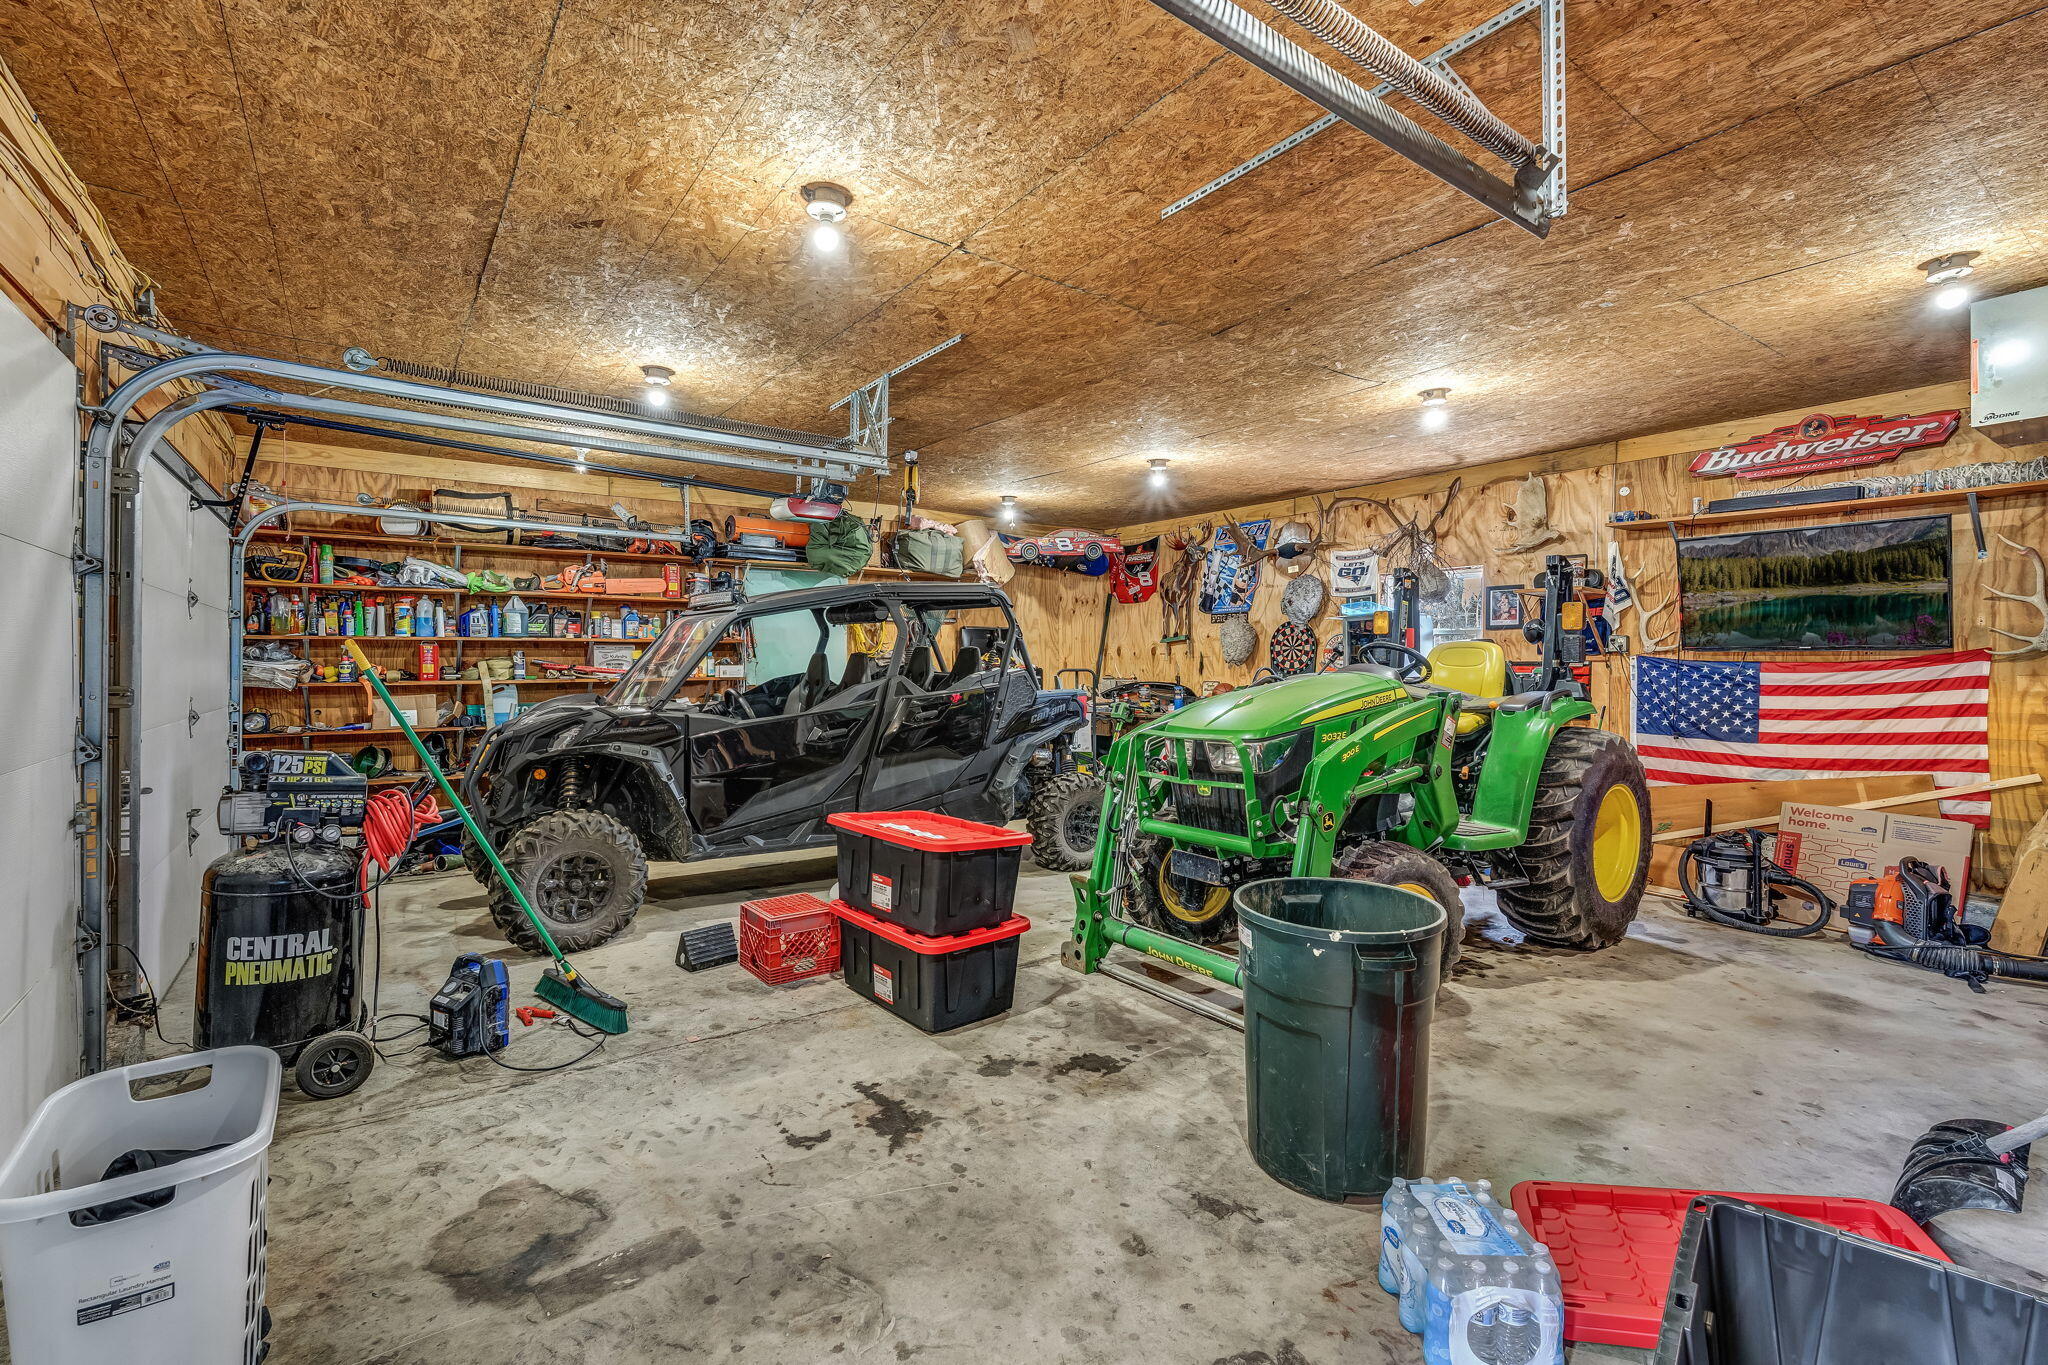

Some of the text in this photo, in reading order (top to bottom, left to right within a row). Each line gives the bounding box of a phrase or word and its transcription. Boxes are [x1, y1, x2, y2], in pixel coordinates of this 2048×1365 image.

[1982, 411, 2021, 421] MODINE
[1696, 421, 1944, 473] Budweiser
[1843, 454, 1876, 464] LAGER
[1055, 537, 1074, 551] 8
[1337, 565, 1370, 577] GO!
[1137, 571, 1153, 587] 8
[1360, 693, 1393, 710] JOHN DEERE
[1321, 731, 1347, 743] 3032E
[271, 754, 304, 775] 125
[303, 760, 328, 775] PSI
[1789, 806, 1854, 823] Welcome
[1788, 816, 1830, 831] home.
[1784, 843, 1795, 871] small
[1840, 858, 1866, 869] LOWE'S
[226, 928, 333, 961] CENTRAL
[1146, 945, 1214, 977] JOHN DEERE
[78, 1290, 118, 1304] Rectangular
